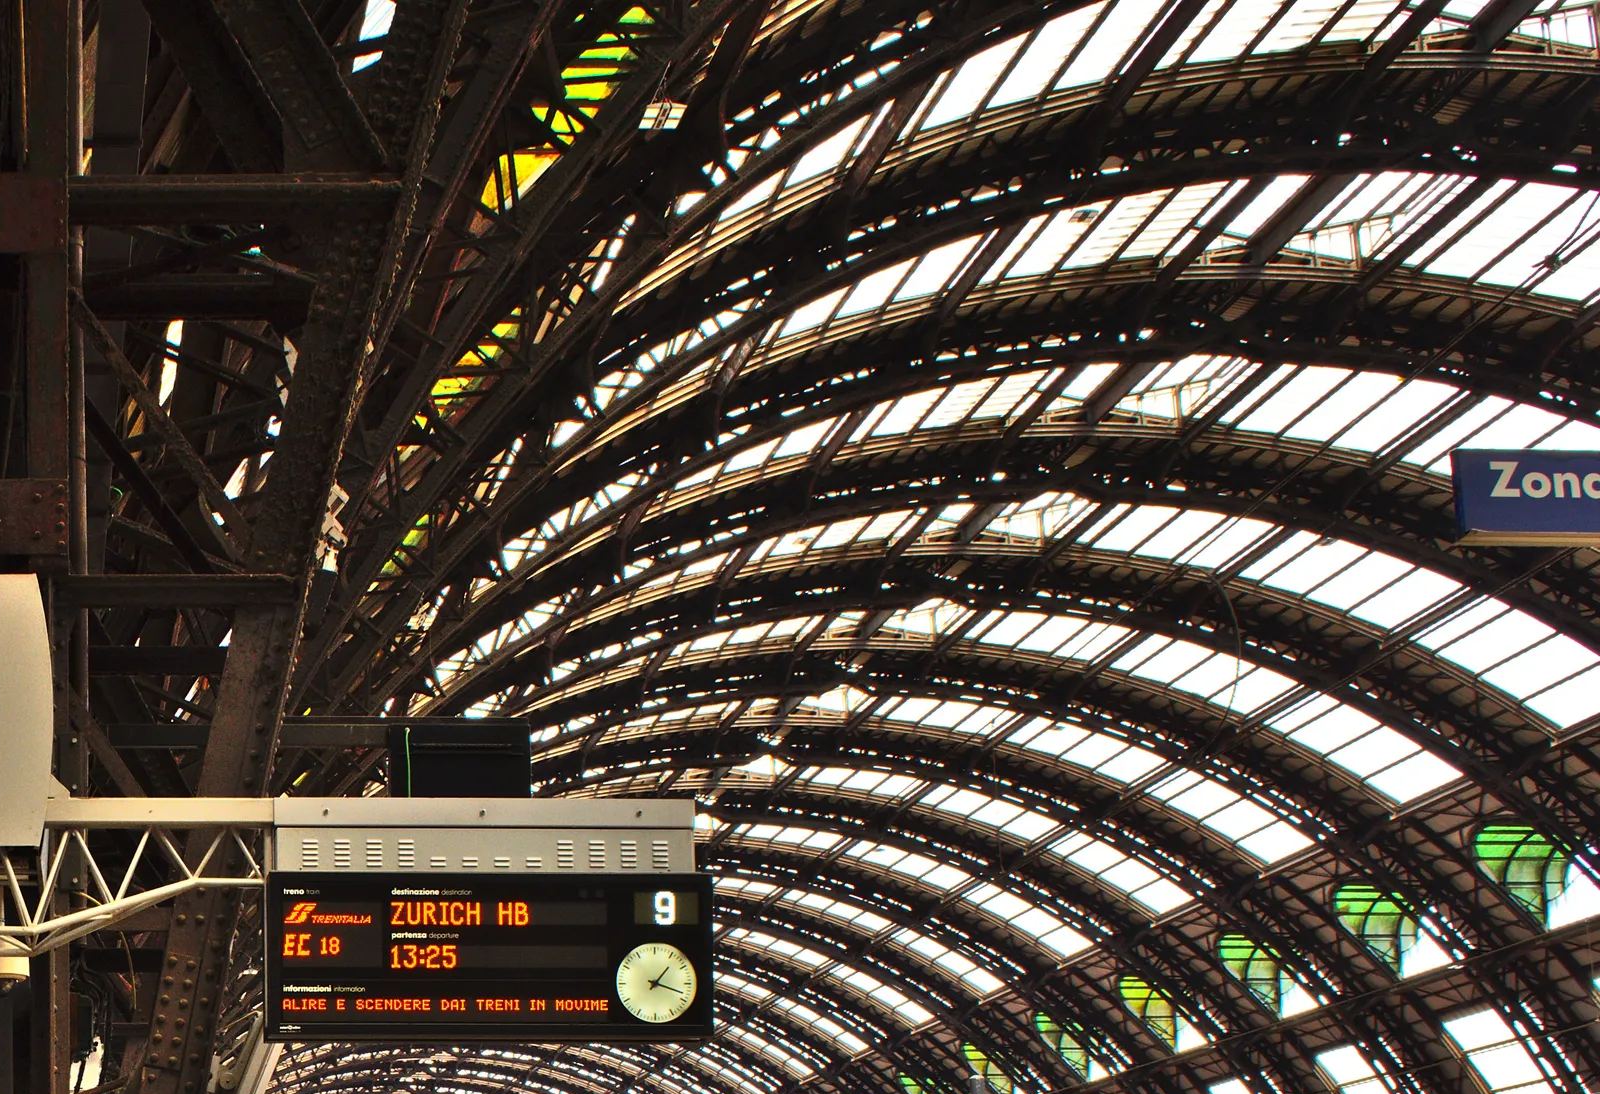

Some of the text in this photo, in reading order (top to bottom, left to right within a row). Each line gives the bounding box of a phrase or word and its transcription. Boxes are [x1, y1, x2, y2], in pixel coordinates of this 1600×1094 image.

[391, 888, 440, 896] destinazione
[390, 902, 529, 926] ZURICH HB
[654, 891, 676, 925] 9
[311, 915, 371, 924] TRENITALIA
[391, 932, 460, 940] partenza departure
[283, 933, 340, 956] EC 18
[391, 945, 457, 969] 13:25
[283, 984, 366, 993] informazioni information
[282, 998, 609, 1011] ALIRE E SCENDERE DAI TRENI IN MOVIME
